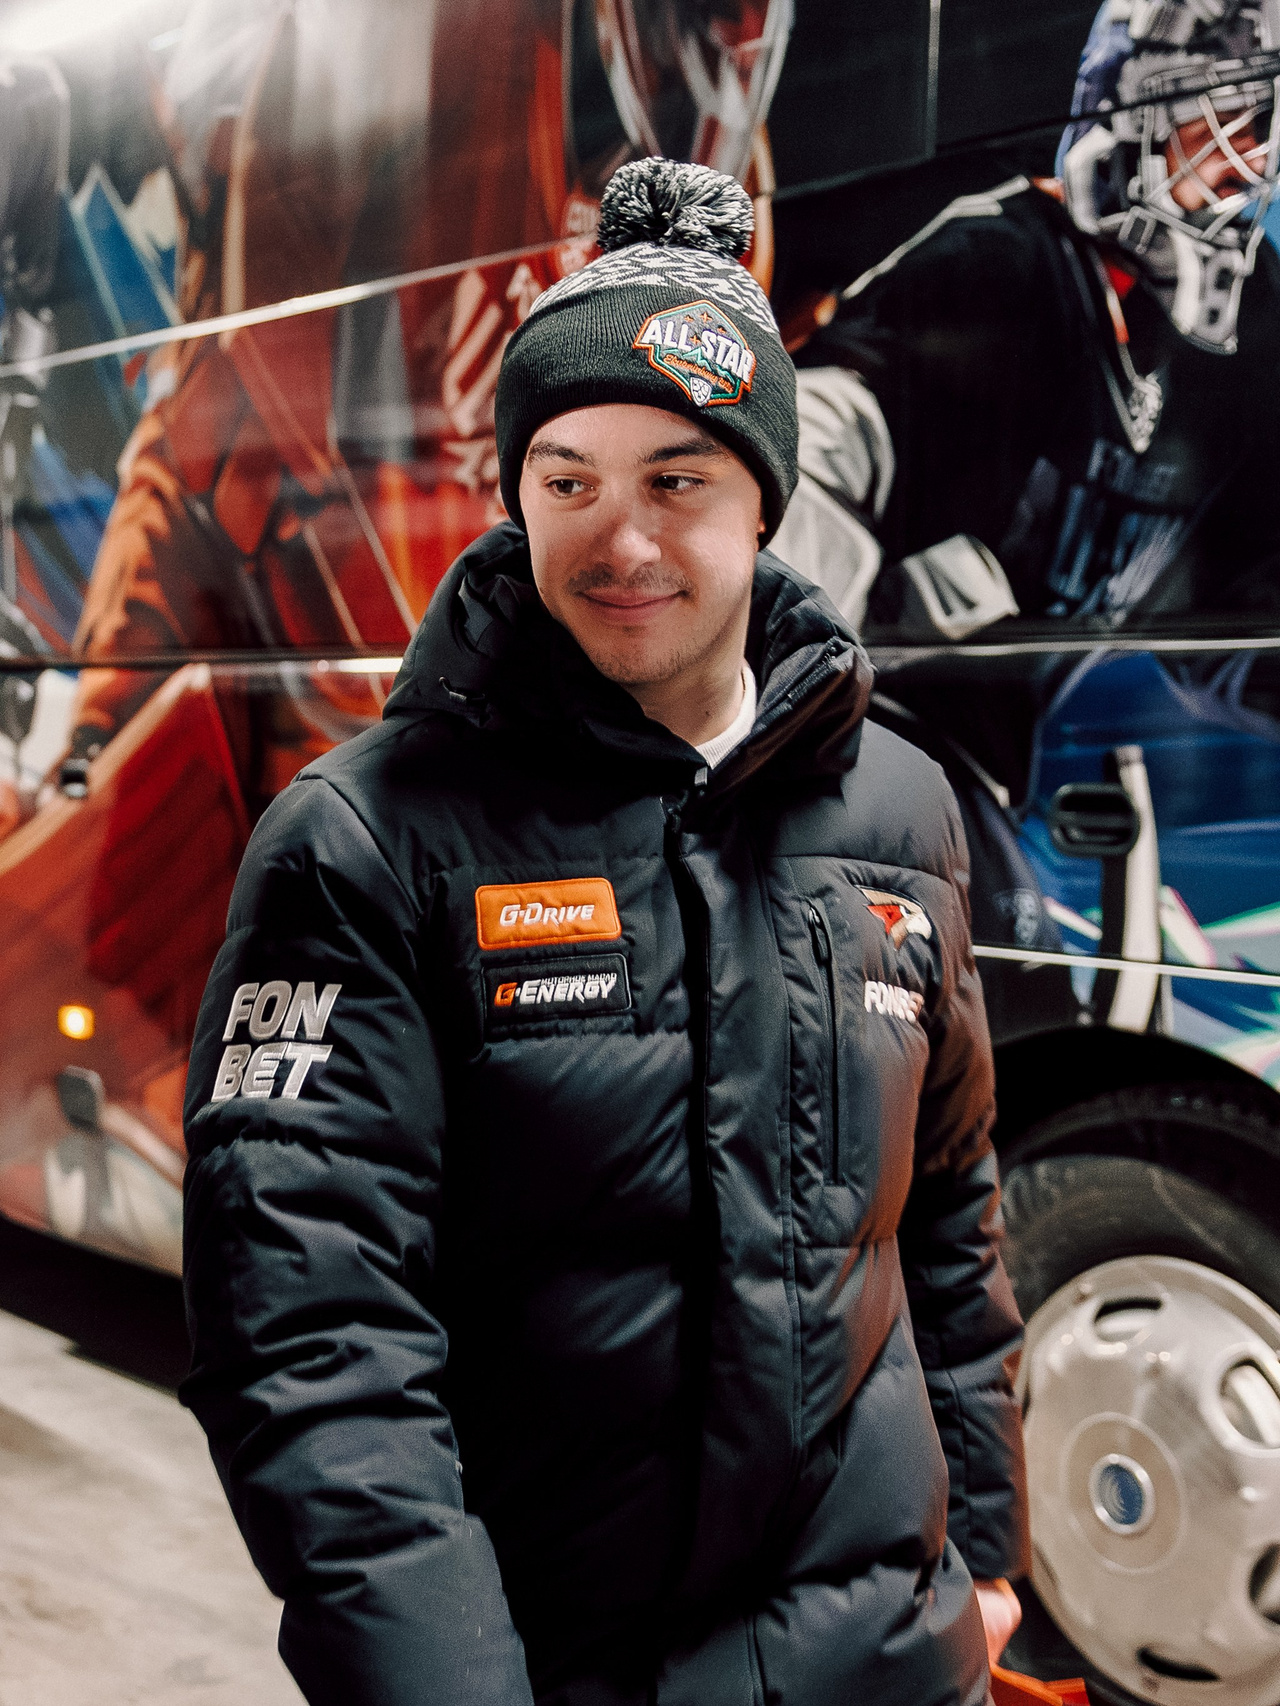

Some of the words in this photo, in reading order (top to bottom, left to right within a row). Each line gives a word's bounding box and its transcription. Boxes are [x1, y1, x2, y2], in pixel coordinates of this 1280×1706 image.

[640, 319, 692, 351] ALL
[700, 329, 755, 384] STAR
[222, 980, 343, 1042] FON
[211, 1042, 334, 1102] BET
